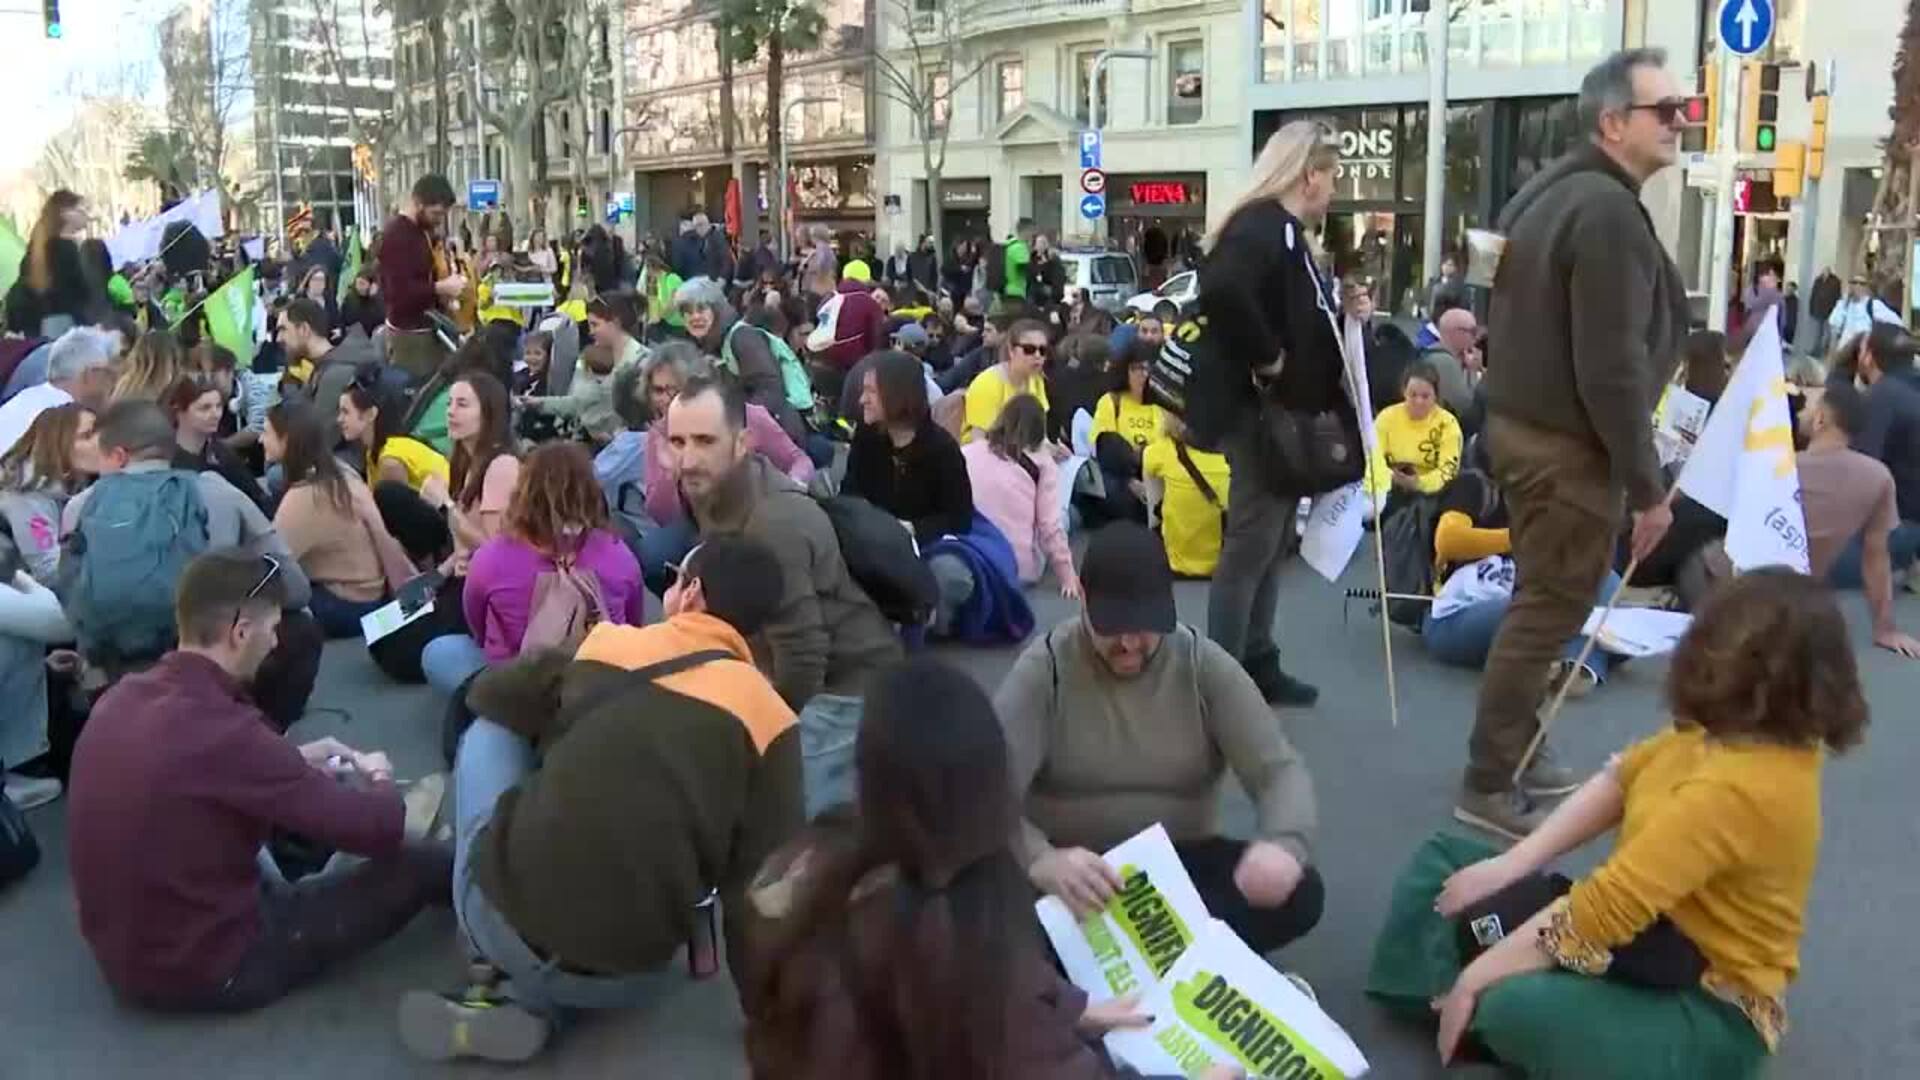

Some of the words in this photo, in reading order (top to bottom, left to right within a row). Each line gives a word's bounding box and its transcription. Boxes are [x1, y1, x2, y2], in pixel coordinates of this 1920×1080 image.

[1083, 132, 1097, 152] P
[1340, 129, 1393, 156] ONS
[1336, 164, 1392, 178] ONDE
[1764, 507, 1807, 560] (asp
